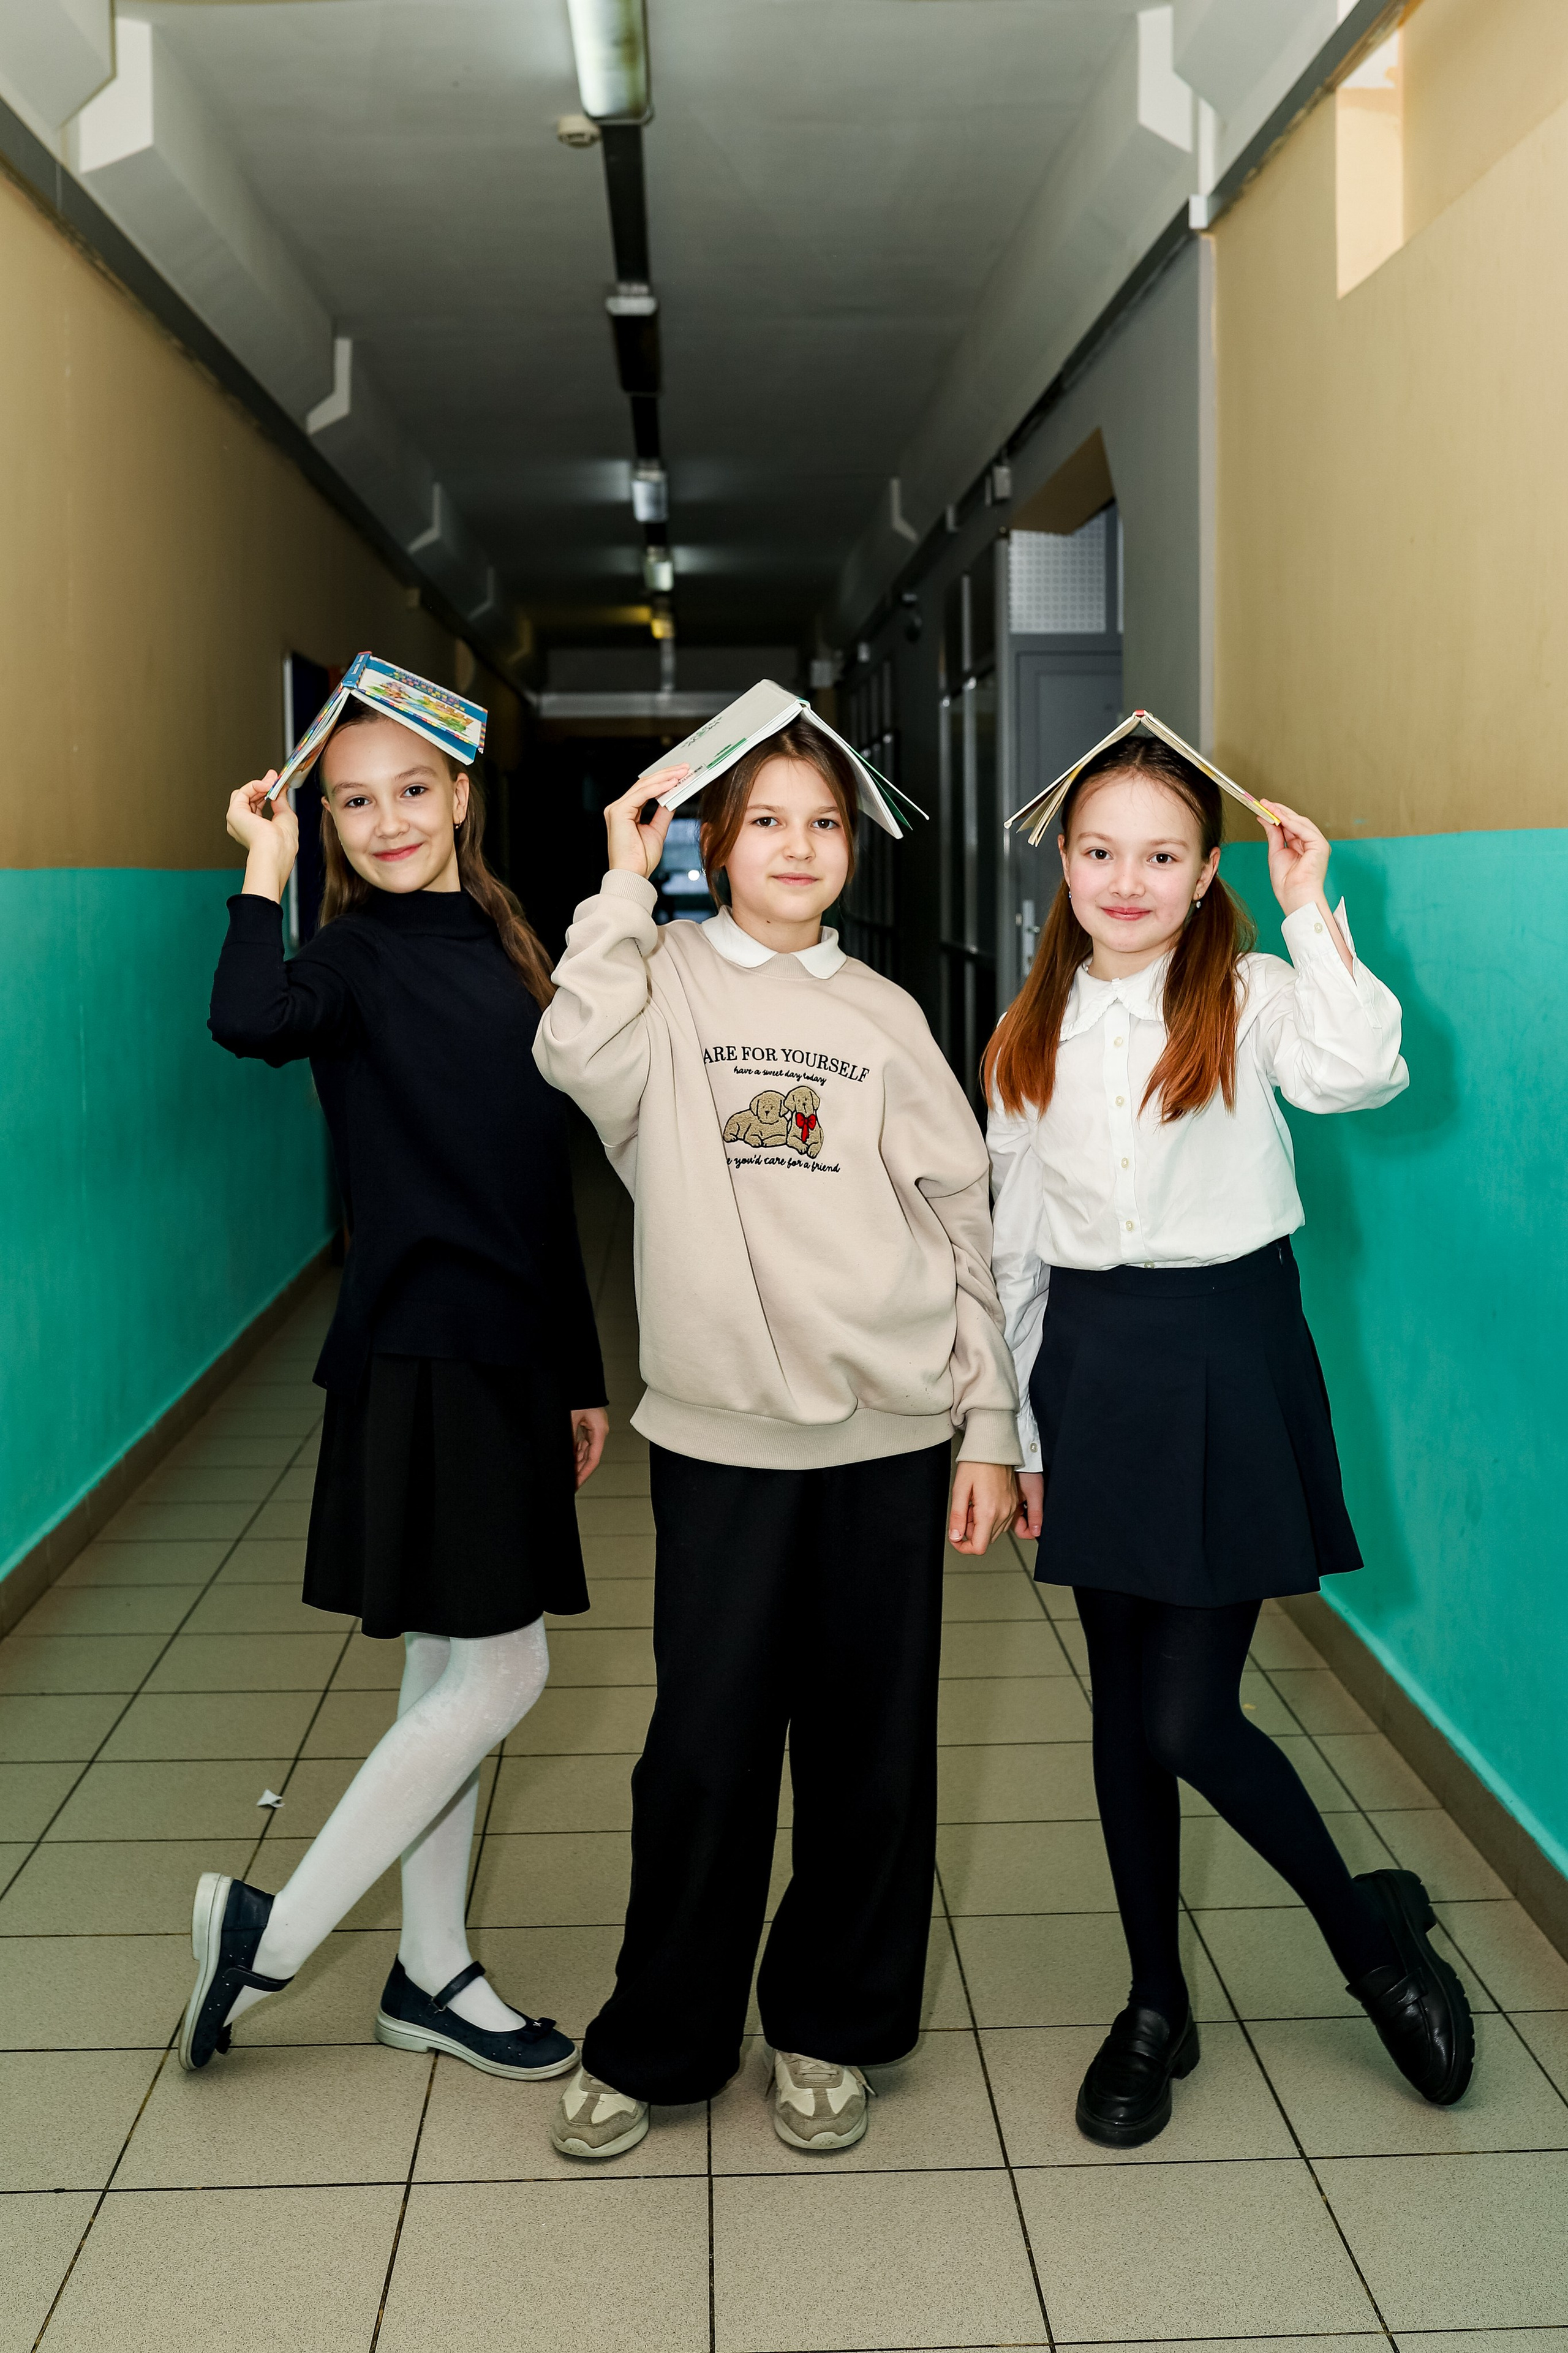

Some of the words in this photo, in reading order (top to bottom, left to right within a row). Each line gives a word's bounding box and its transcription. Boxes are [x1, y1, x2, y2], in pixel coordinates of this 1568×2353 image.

[741, 1046, 778, 1061] FOR
[780, 1049, 870, 1082] YOURSELF
[785, 1070, 802, 1082] day
[803, 1073, 826, 1086] today
[734, 1155, 762, 1168] you'd
[787, 1158, 802, 1168] for
[812, 1161, 840, 1173] friend
